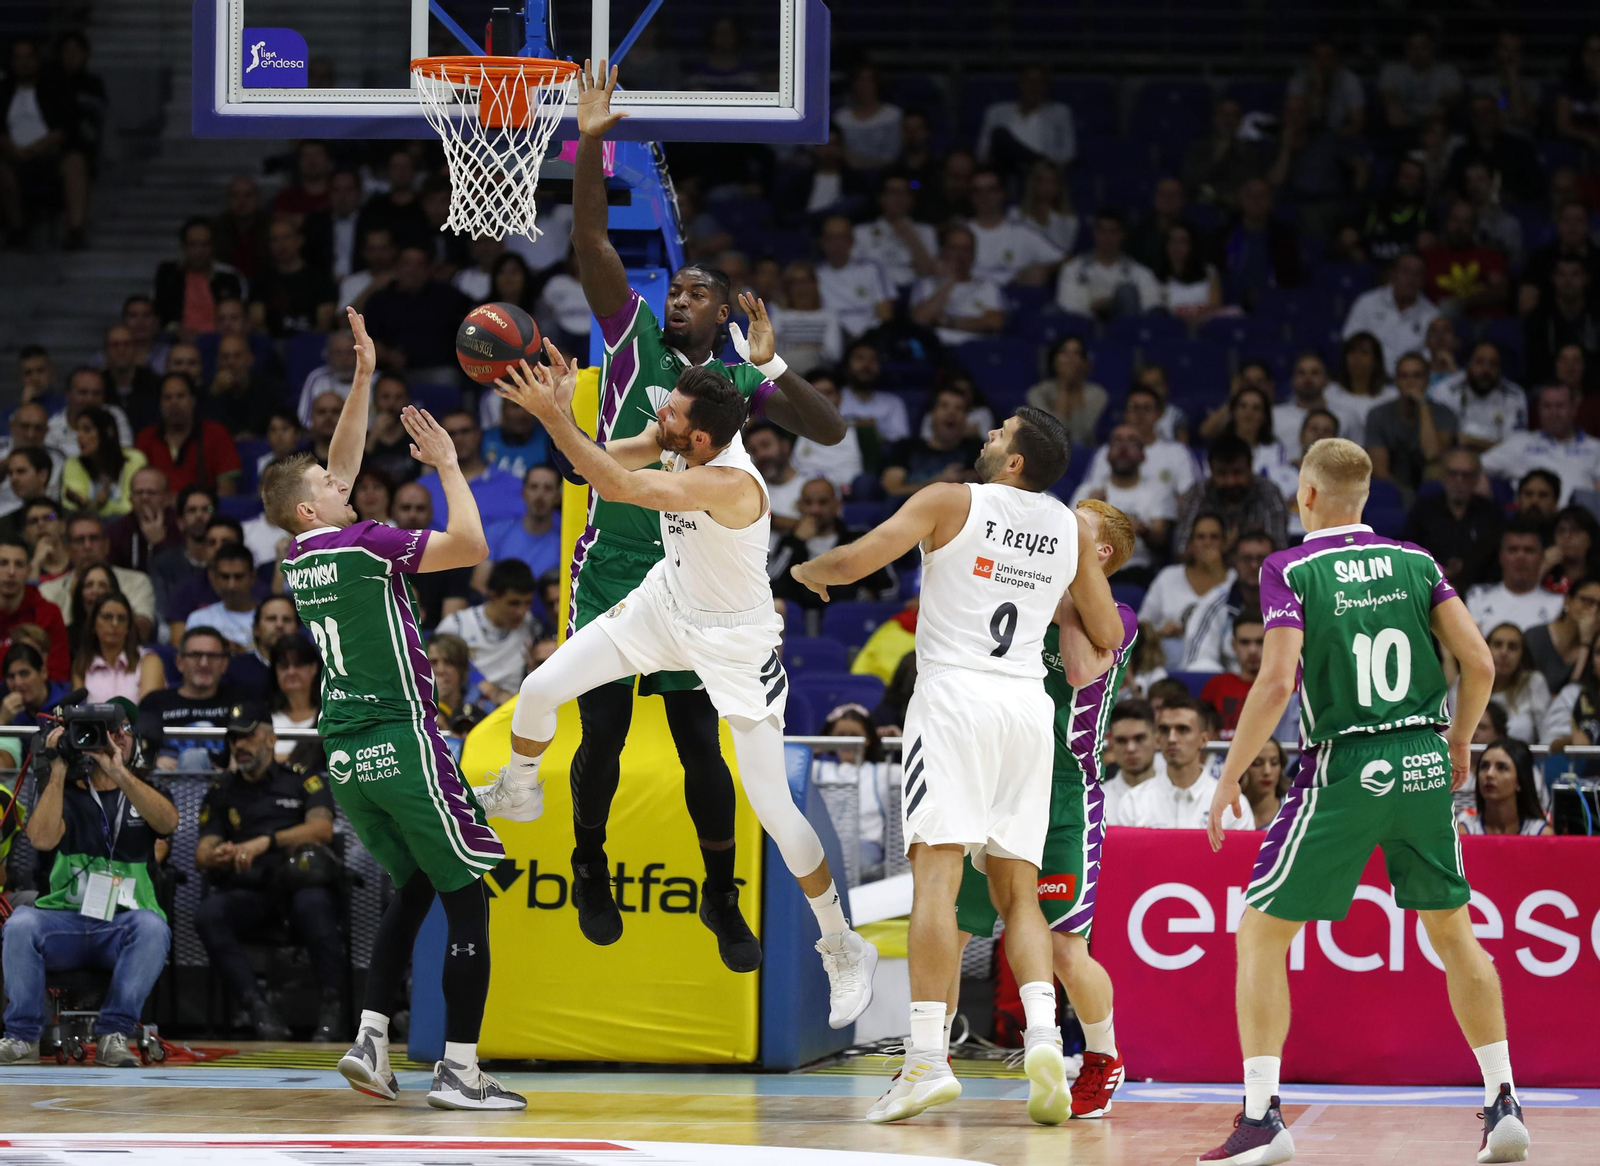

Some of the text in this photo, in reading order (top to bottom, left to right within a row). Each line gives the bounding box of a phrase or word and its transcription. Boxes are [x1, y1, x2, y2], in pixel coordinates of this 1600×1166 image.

[260, 46, 277, 60] liga
[260, 58, 304, 69] endesa
[986, 520, 1059, 556] F. REYES
[996, 562, 1053, 585] Universidad
[1334, 555, 1393, 583] SALIN
[994, 573, 1036, 590] Europea
[989, 602, 1018, 659] 9
[1352, 627, 1412, 707] 10
[356, 742, 397, 761] COSTA
[1402, 751, 1444, 769] COSTA
[355, 755, 399, 773] DEL SOL
[1402, 764, 1445, 782] DEL SOL
[357, 766, 401, 783] MÁLAGA
[1402, 776, 1447, 793] MÁLAGA
[527, 859, 747, 914] btfa
[1127, 882, 1600, 978] edes
